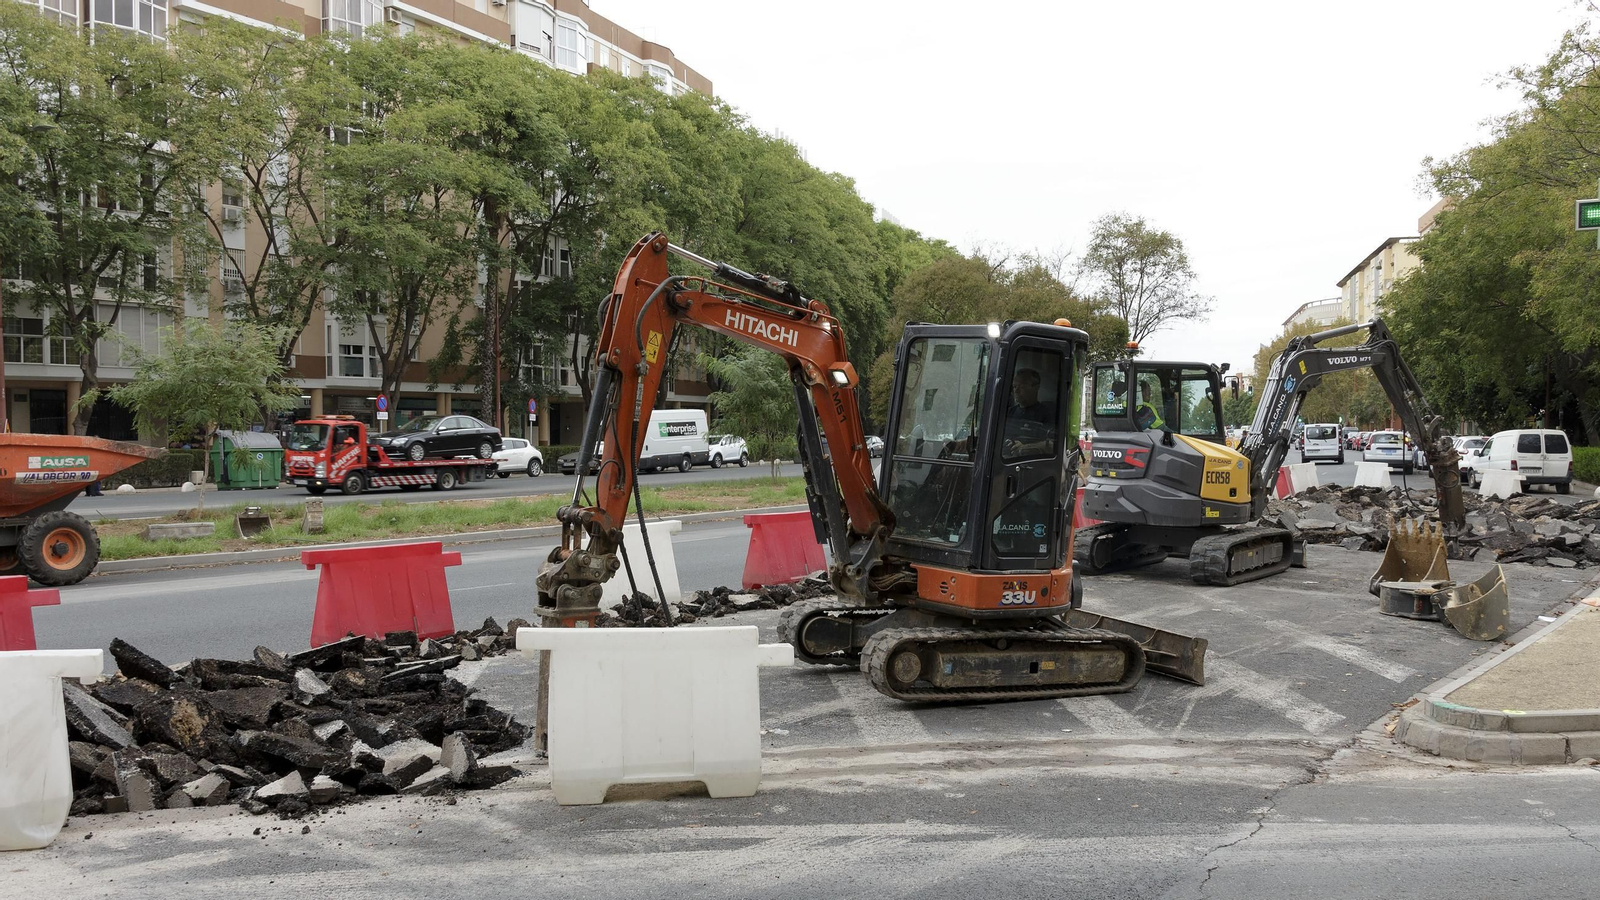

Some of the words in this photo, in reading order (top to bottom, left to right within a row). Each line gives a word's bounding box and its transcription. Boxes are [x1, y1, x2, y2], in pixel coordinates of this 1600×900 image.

[725, 309, 798, 347] HITACHI
[1327, 355, 1357, 365] VOLVO
[661, 424, 696, 435] enterprise
[1093, 449, 1122, 459] VOLVO
[42, 457, 87, 466] AUSA
[1205, 471, 1231, 485] ECR58
[1003, 581, 1028, 590] ZAXIS
[1001, 590, 1036, 605] 33U
